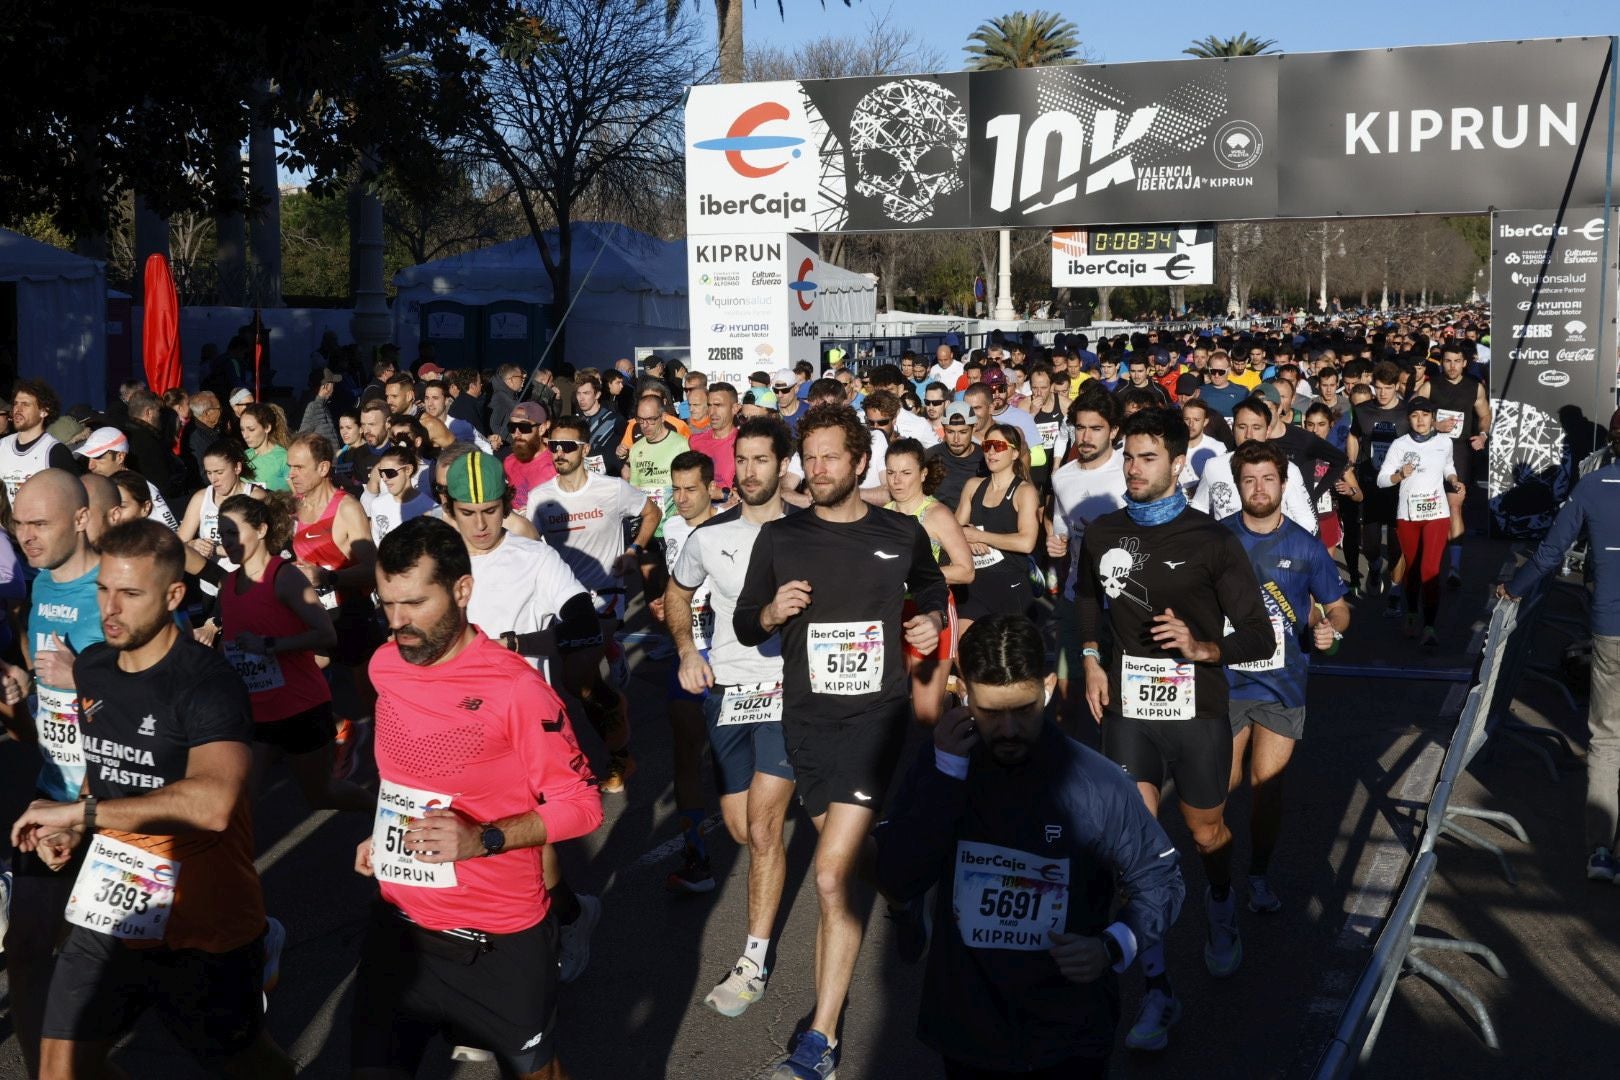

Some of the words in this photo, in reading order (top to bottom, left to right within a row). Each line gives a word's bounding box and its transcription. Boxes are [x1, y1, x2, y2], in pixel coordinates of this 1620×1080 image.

[1345, 102, 1577, 155] KIPRUN
[986, 104, 1161, 215] 10K
[1137, 165, 1192, 178] VALENCIA
[1136, 176, 1201, 191] IBERCAJA
[1209, 176, 1253, 188] KIPRUN
[699, 191, 806, 219] iberCaja
[1500, 223, 1568, 238] iberCaa
[1095, 231, 1172, 251] 0:08:34
[696, 242, 782, 263] KIPRUN
[1563, 256, 1598, 264] Esfuerzo
[1564, 248, 1591, 257] Cultura
[751, 271, 776, 279] Cultura
[1068, 258, 1147, 278] iberCaja
[751, 278, 782, 286] Esfuerzo
[1537, 301, 1582, 309] HYUNDAI
[729, 323, 769, 331] HYUNDAI
[790, 321, 819, 340] iberCaja
[708, 346, 744, 361] 226ERS
[706, 369, 741, 383] divina
[1416, 502, 1437, 512] 5592
[548, 507, 604, 525] Delibreads
[692, 613, 713, 628] 657
[810, 629, 856, 640] iberCaja
[827, 652, 868, 674] 5152
[1125, 661, 1166, 674] iberCaja
[824, 680, 870, 691] KIPRUN
[1138, 684, 1178, 702] 5128
[733, 696, 772, 711] 5020
[730, 712, 772, 722] KIPRUN
[1136, 707, 1181, 717] KIPRUN
[43, 719, 77, 744] 5338
[102, 756, 121, 768] YOU
[99, 765, 165, 789] FASTER
[380, 788, 416, 810] iberCaja
[94, 842, 146, 869] iberCaja
[961, 850, 1027, 872] iberCaja
[380, 863, 436, 883] KIPRUN
[94, 877, 153, 916] 3693
[979, 888, 1043, 921] 5691
[84, 911, 146, 936] KIPRUN
[1051, 917, 1059, 929] 7
[972, 928, 1042, 946] KIPRUN
